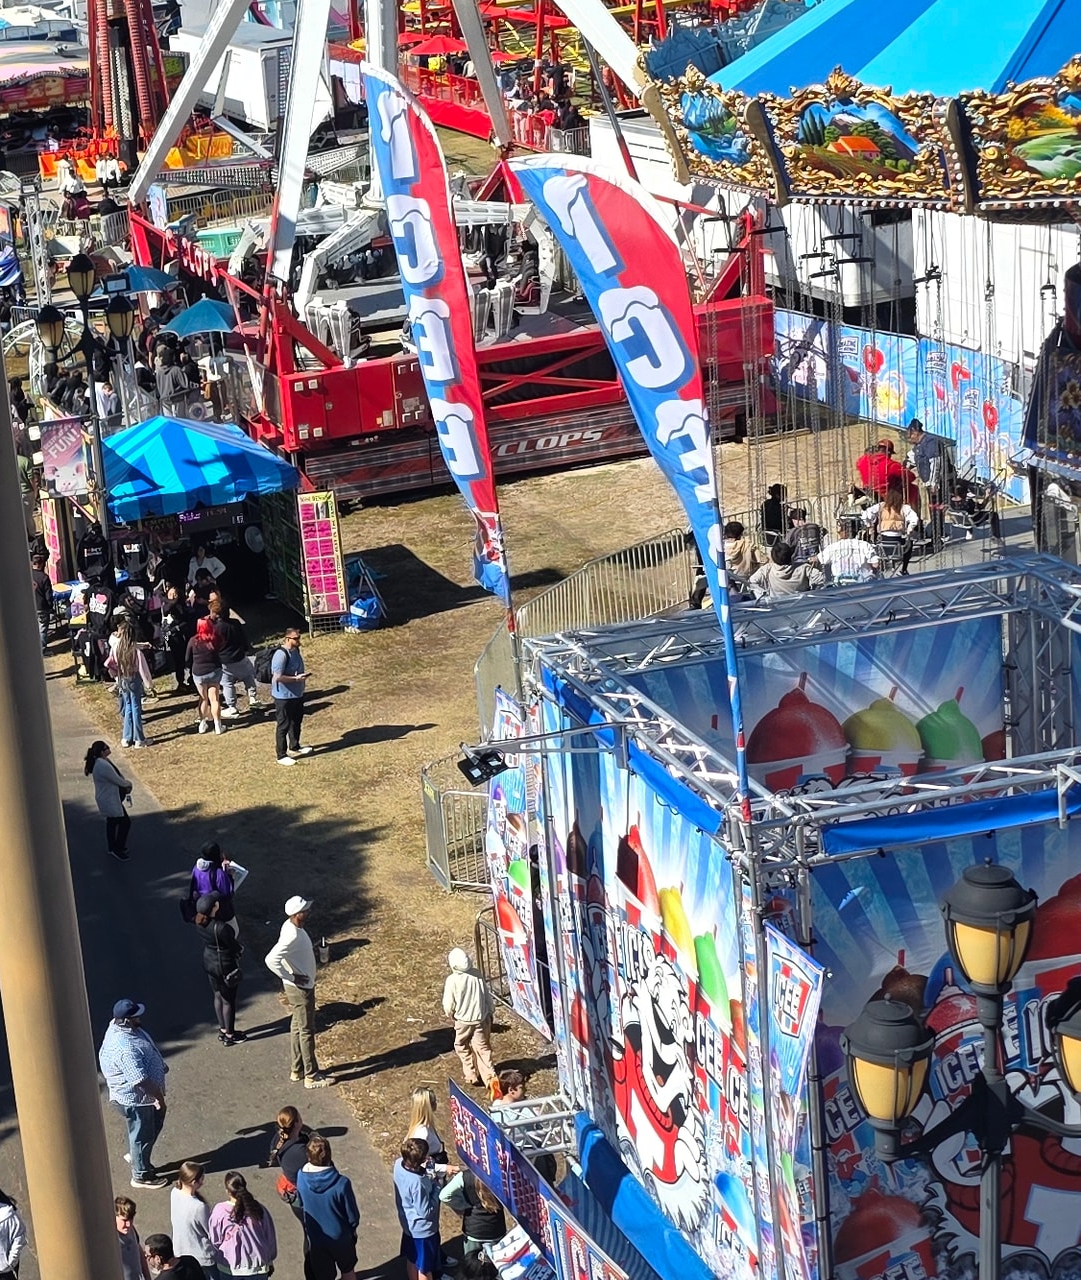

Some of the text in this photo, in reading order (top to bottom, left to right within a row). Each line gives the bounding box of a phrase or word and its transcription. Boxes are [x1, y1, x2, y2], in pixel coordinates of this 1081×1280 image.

[48, 428, 81, 459] FUN!
[774, 972, 803, 1024] ICEE
[450, 1094, 491, 1176] GET
